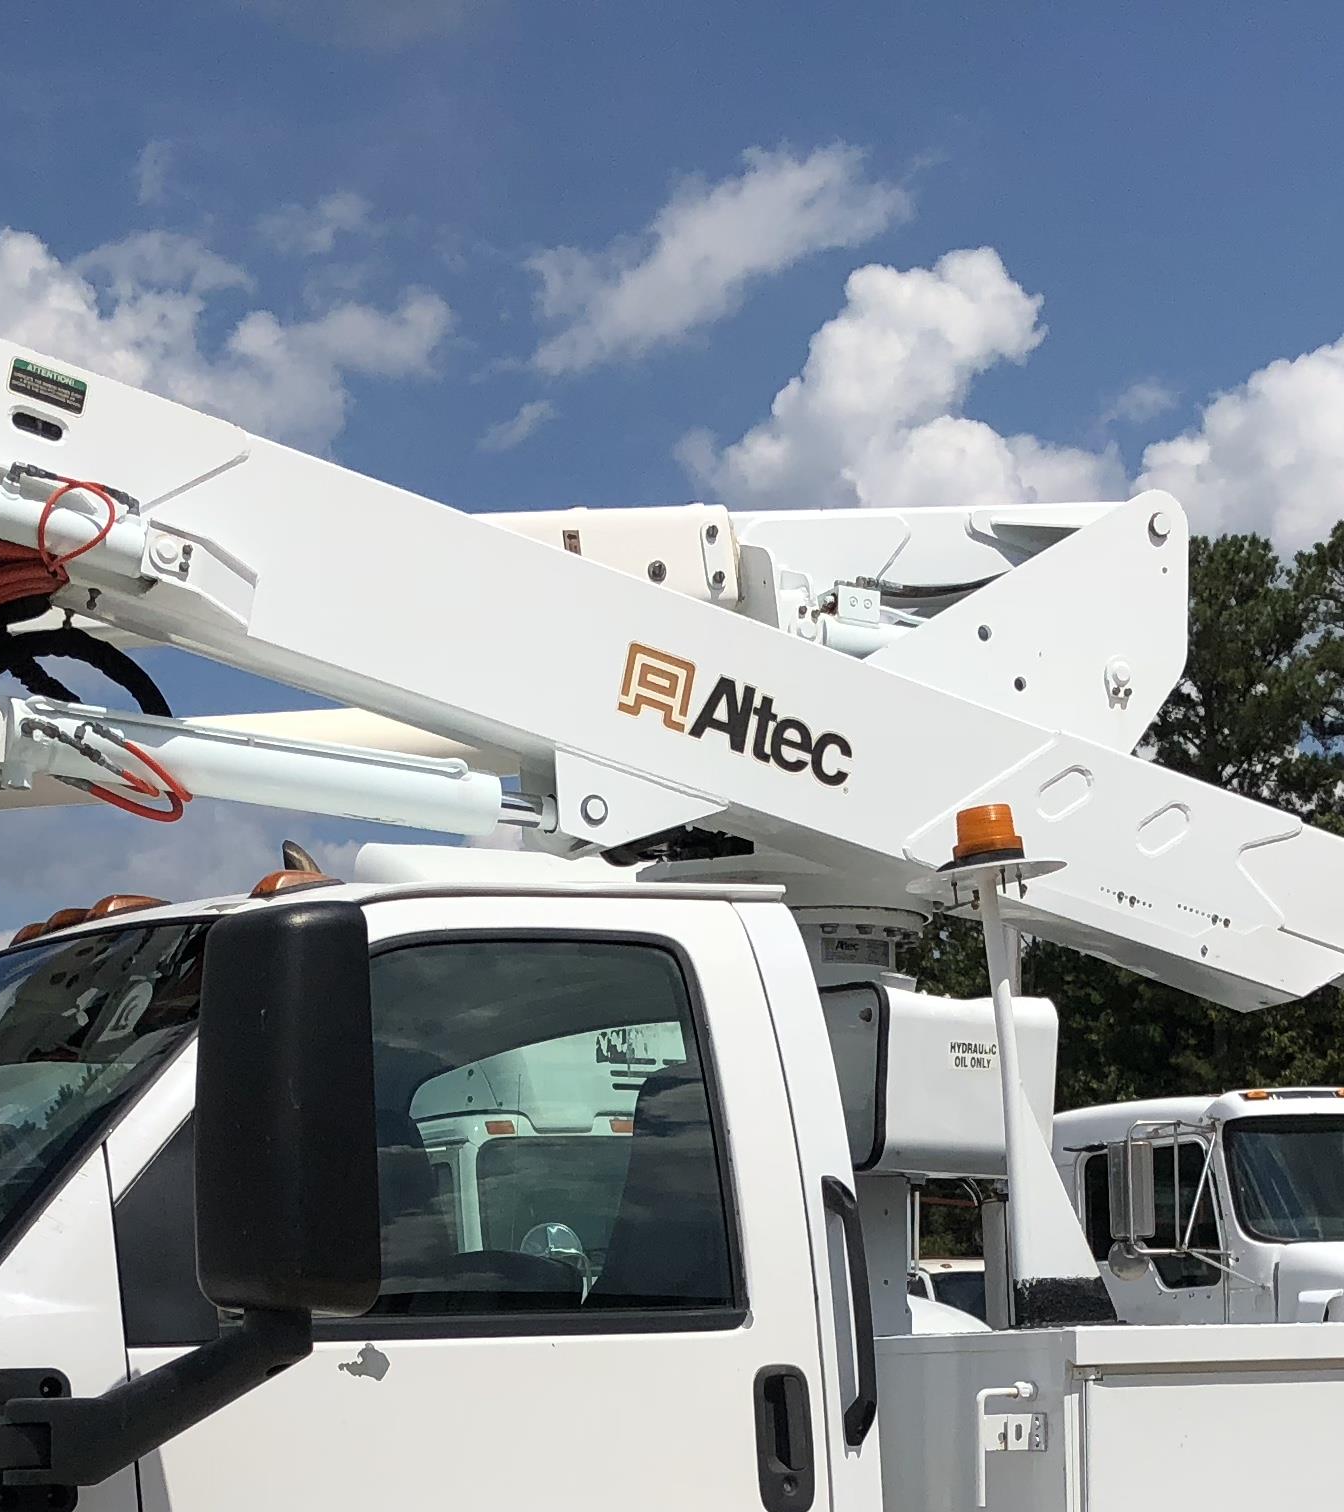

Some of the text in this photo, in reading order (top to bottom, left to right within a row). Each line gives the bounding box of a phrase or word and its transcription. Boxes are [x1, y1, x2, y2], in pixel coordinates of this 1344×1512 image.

[688, 676, 853, 787] Altec
[954, 1056, 992, 1069] OIL ONLY
